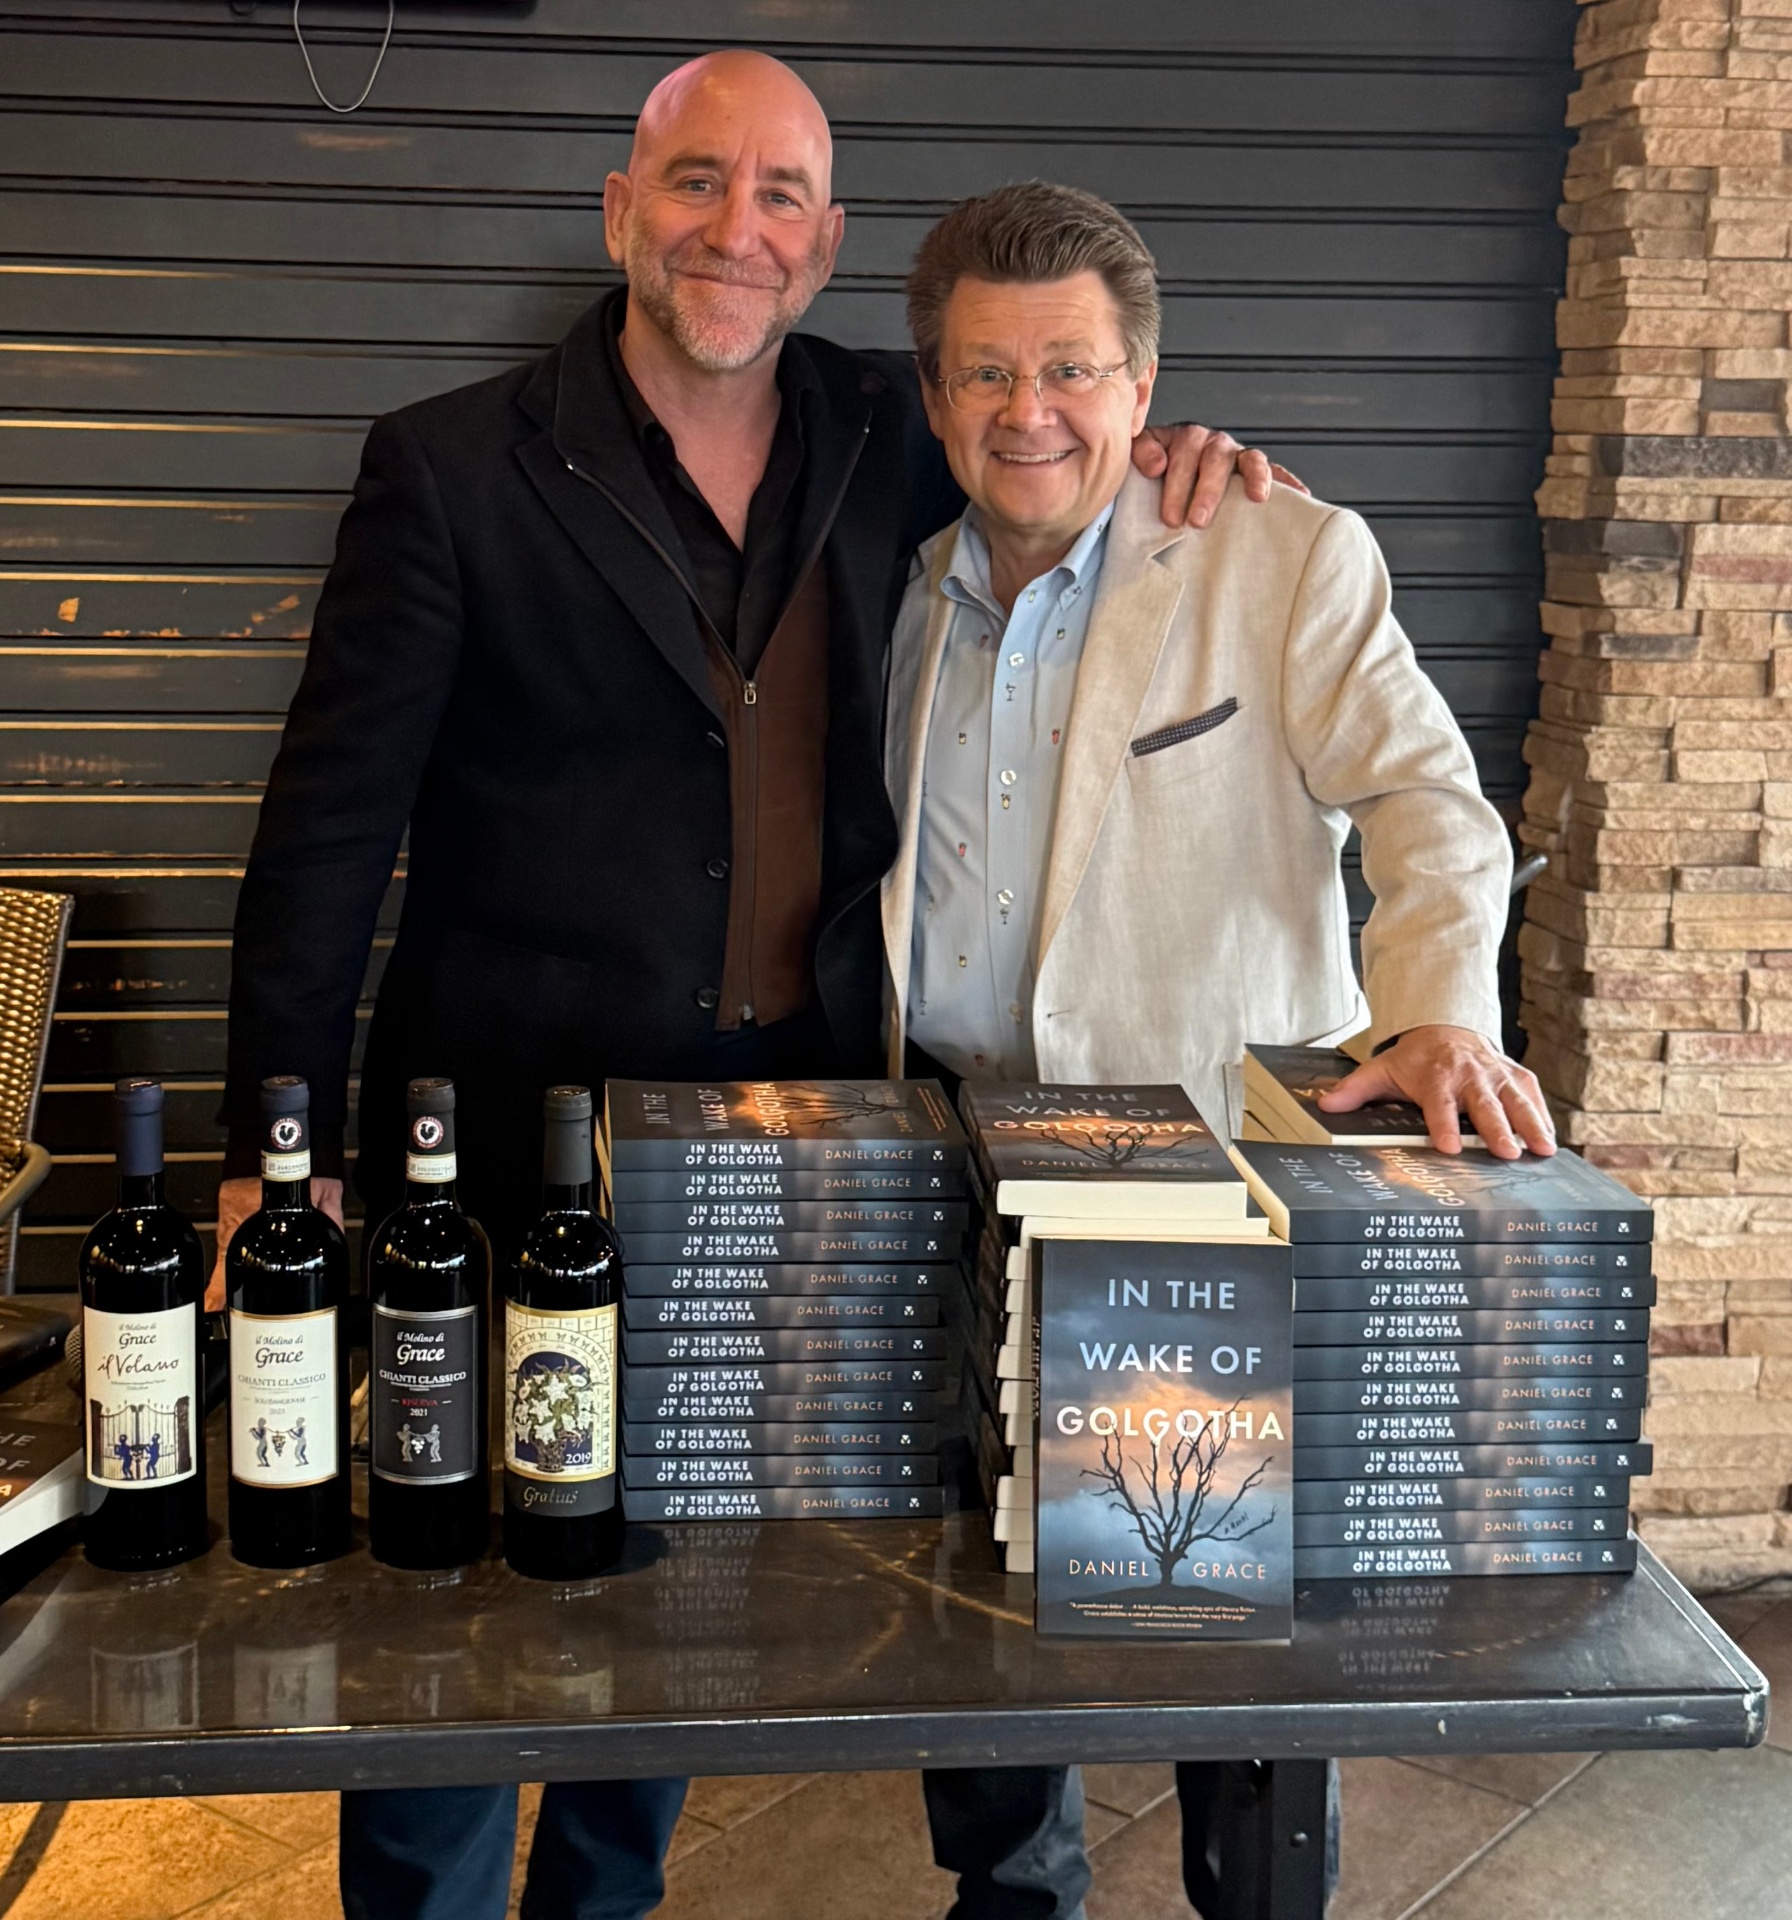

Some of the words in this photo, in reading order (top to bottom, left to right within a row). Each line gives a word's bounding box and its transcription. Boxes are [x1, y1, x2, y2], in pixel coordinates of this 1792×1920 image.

[697, 1088, 723, 1103] OF
[1024, 1091, 1062, 1100] IN
[1076, 1092, 1138, 1102] THE
[643, 1093, 668, 1111] THE
[751, 1082, 791, 1137] GOLGOTHA
[1006, 1105, 1111, 1117] WAKE
[1126, 1108, 1171, 1117] OF
[646, 1112, 671, 1125] IN
[702, 1104, 730, 1132] WAKE
[993, 1121, 1205, 1133] GOLGOTHA
[691, 1144, 706, 1154] IN
[711, 1144, 735, 1154] THE
[740, 1144, 778, 1154] WAKE
[825, 1150, 868, 1159] DANIEL
[874, 1150, 913, 1159] GRACE
[686, 1154, 703, 1164] OF
[708, 1154, 783, 1164] GOLGOTHA
[1022, 1160, 1099, 1168] DANIEL
[1329, 1152, 1362, 1168] OF
[1279, 1157, 1317, 1178] THE
[691, 1174, 706, 1184] IN
[711, 1174, 735, 1184] THE
[740, 1174, 778, 1184] WAKE
[825, 1178, 868, 1188] DANIEL
[874, 1178, 913, 1188] GRACE
[1380, 1148, 1466, 1207] GOLGOTHA
[686, 1184, 703, 1195] OF
[708, 1184, 783, 1195] GOLGOTHA
[1299, 1181, 1334, 1195] IN
[1346, 1169, 1399, 1201] WAKE
[693, 1204, 708, 1215] IN
[713, 1204, 737, 1215] THE
[742, 1204, 780, 1215] WAKE
[688, 1216, 705, 1225] OF
[710, 1216, 785, 1225] GOLGOTHA
[827, 1211, 870, 1220] DANIEL
[876, 1211, 914, 1220] GRACE
[1370, 1216, 1385, 1227] IN
[1391, 1216, 1415, 1227] THE
[1420, 1216, 1460, 1227] WAKE
[1507, 1221, 1551, 1232] DANIEL
[1556, 1221, 1597, 1232] GRACE
[1364, 1228, 1382, 1237] OF
[1387, 1228, 1464, 1237] GOLGOTHA
[687, 1236, 702, 1246] IN
[708, 1236, 732, 1246] THE
[736, 1236, 774, 1246] WAKE
[821, 1241, 864, 1250] DANIEL
[870, 1241, 909, 1250] GRACE
[682, 1246, 699, 1255] OF
[704, 1246, 779, 1255] GOLGOTHA
[1367, 1248, 1382, 1259] IN
[1388, 1248, 1412, 1259] THE
[1417, 1248, 1456, 1259] WAKE
[1361, 1260, 1378, 1270] OF
[1384, 1260, 1461, 1270] GOLGOTHA
[1504, 1255, 1548, 1265] DANIEL
[1553, 1255, 1594, 1265] GRACE
[677, 1268, 692, 1279] IN
[697, 1268, 721, 1279] THE
[726, 1268, 764, 1279] WAKE
[811, 1274, 853, 1284] DANIEL
[860, 1274, 898, 1284] GRACE
[672, 1280, 689, 1288] OF
[694, 1280, 769, 1288] GOLGOTHA
[1376, 1284, 1391, 1294] IN
[1397, 1284, 1421, 1294] THE
[1426, 1284, 1466, 1294] WAKE
[1108, 1279, 1148, 1307] IN
[1166, 1280, 1235, 1310] THE
[1512, 1287, 1556, 1298] DANIEL
[1562, 1287, 1602, 1298] GRACE
[664, 1300, 679, 1311] IN
[684, 1300, 708, 1311] THE
[713, 1300, 751, 1311] WAKE
[1370, 1295, 1388, 1305] OF
[1393, 1295, 1470, 1305] GOLGOTHA
[798, 1305, 840, 1315] DANIEL
[847, 1305, 885, 1315] GRACE
[659, 1312, 676, 1321] OF
[681, 1312, 756, 1321] GOLGOTHA
[1369, 1316, 1384, 1326] IN
[1390, 1316, 1414, 1326] THE
[1419, 1316, 1459, 1326] WAKE
[1506, 1320, 1549, 1331] DANIEL
[1555, 1320, 1595, 1331] GRACE
[396, 1332, 403, 1341] il
[404, 1333, 434, 1343] Molino
[435, 1332, 444, 1342] di
[1363, 1327, 1381, 1337] OF
[1386, 1327, 1463, 1337] GOLGOTHA
[119, 1332, 157, 1349] Grace
[255, 1335, 262, 1345] il
[263, 1336, 293, 1345] Molino
[295, 1335, 303, 1344] di
[673, 1336, 688, 1346] IN
[694, 1336, 718, 1346] THE
[722, 1336, 760, 1346] WAKE
[807, 1340, 849, 1349] DANIEL
[856, 1340, 894, 1349] GRACE
[396, 1344, 445, 1366] Grace
[668, 1346, 685, 1356] OF
[690, 1346, 765, 1356] GOLGOTHA
[1368, 1350, 1383, 1362] IN
[1389, 1350, 1413, 1362] THE
[1418, 1350, 1457, 1362] WAKE
[255, 1347, 304, 1369] Grace
[1079, 1342, 1193, 1373] WAKE
[1211, 1345, 1261, 1375] OF
[1504, 1354, 1547, 1365] DANIEL
[1553, 1354, 1593, 1365] GRACE
[1362, 1362, 1379, 1373] OF
[1385, 1362, 1462, 1373] GOLGOTHA
[238, 1374, 276, 1387] CHIANTI
[278, 1373, 326, 1387] CLASSICO
[379, 1369, 416, 1384] CHIANTI
[418, 1371, 467, 1384] CLASSICO
[1367, 1384, 1382, 1394] IN
[1388, 1384, 1412, 1394] THE
[1417, 1384, 1456, 1394] WAKE
[1503, 1387, 1546, 1398] DANIEL
[1552, 1387, 1592, 1398] GRACE
[1361, 1394, 1378, 1405] OF
[1384, 1394, 1461, 1405] GOLGOTHA
[410, 1408, 428, 1417] 2021
[1056, 1406, 1284, 1441] GOLGOTHA
[1363, 1416, 1378, 1428] IN
[1384, 1416, 1408, 1428] THE
[1413, 1416, 1452, 1428] WAKE
[1498, 1419, 1542, 1430] DANIEL
[1547, 1419, 1588, 1430] GRACE
[1357, 1428, 1374, 1439] OF
[1380, 1428, 1457, 1439] GOLGOTHA
[565, 1451, 593, 1465] 2019
[1069, 1559, 1149, 1577] DANIEL
[1192, 1562, 1267, 1580] GRACE
